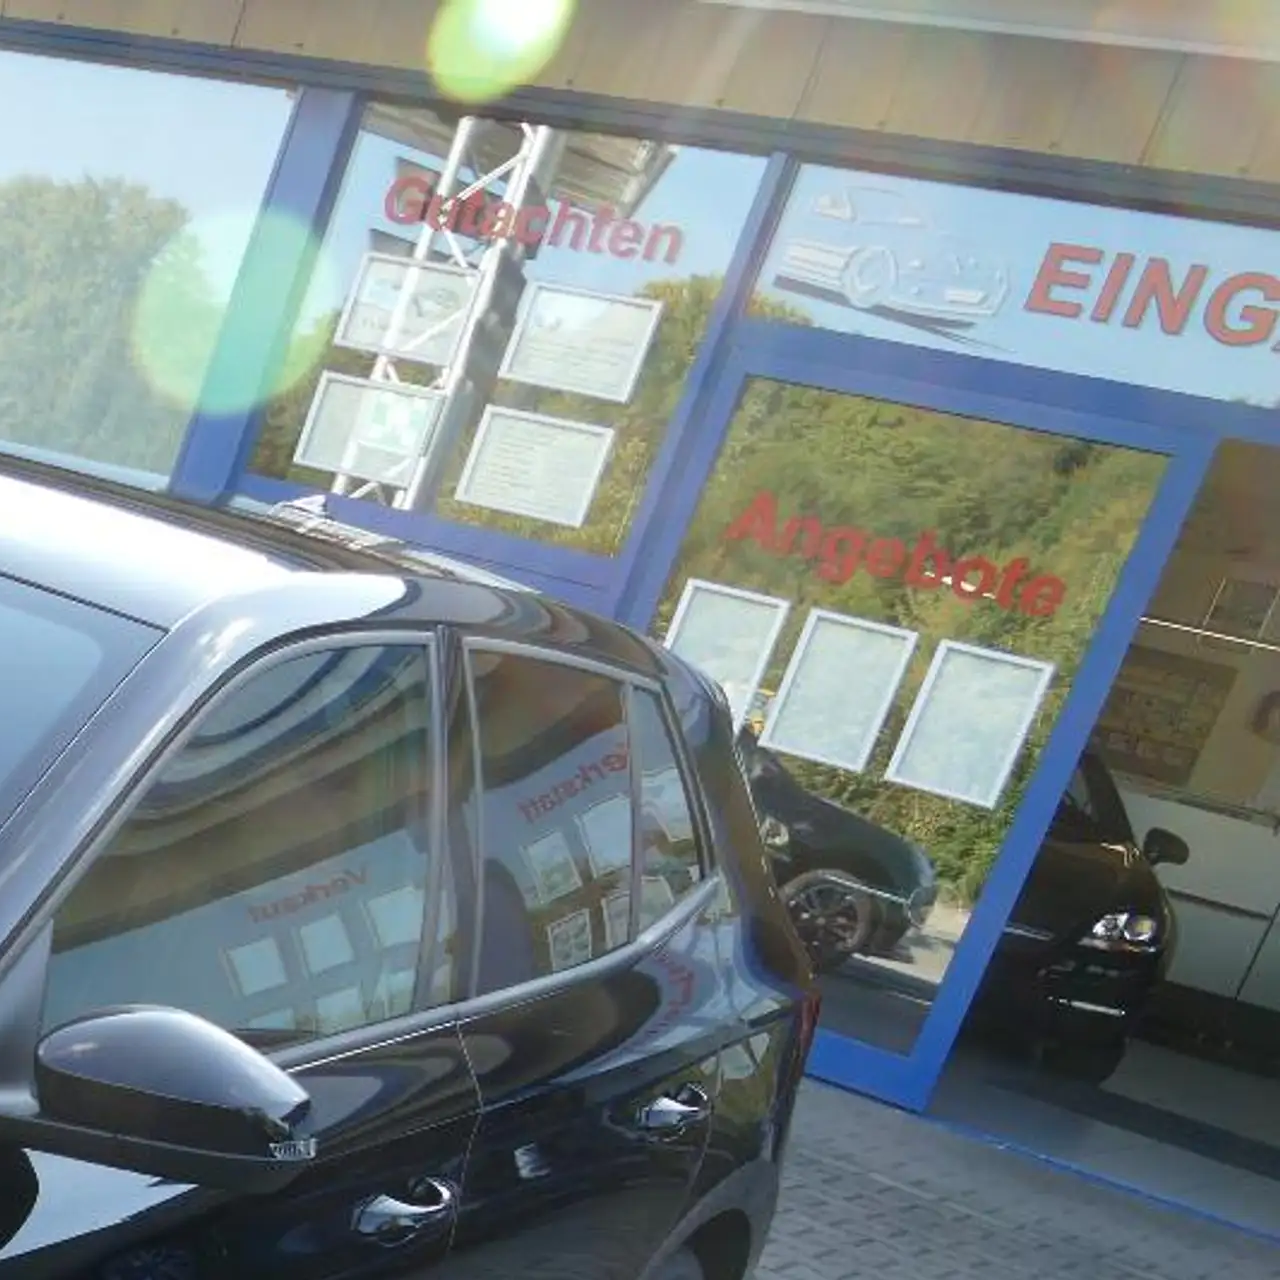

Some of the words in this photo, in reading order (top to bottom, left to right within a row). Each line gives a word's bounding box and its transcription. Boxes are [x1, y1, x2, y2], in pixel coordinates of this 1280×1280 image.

[384, 173, 683, 263] Gutachten
[1024, 241, 1280, 348] EING
[725, 490, 1067, 617] Angebote
